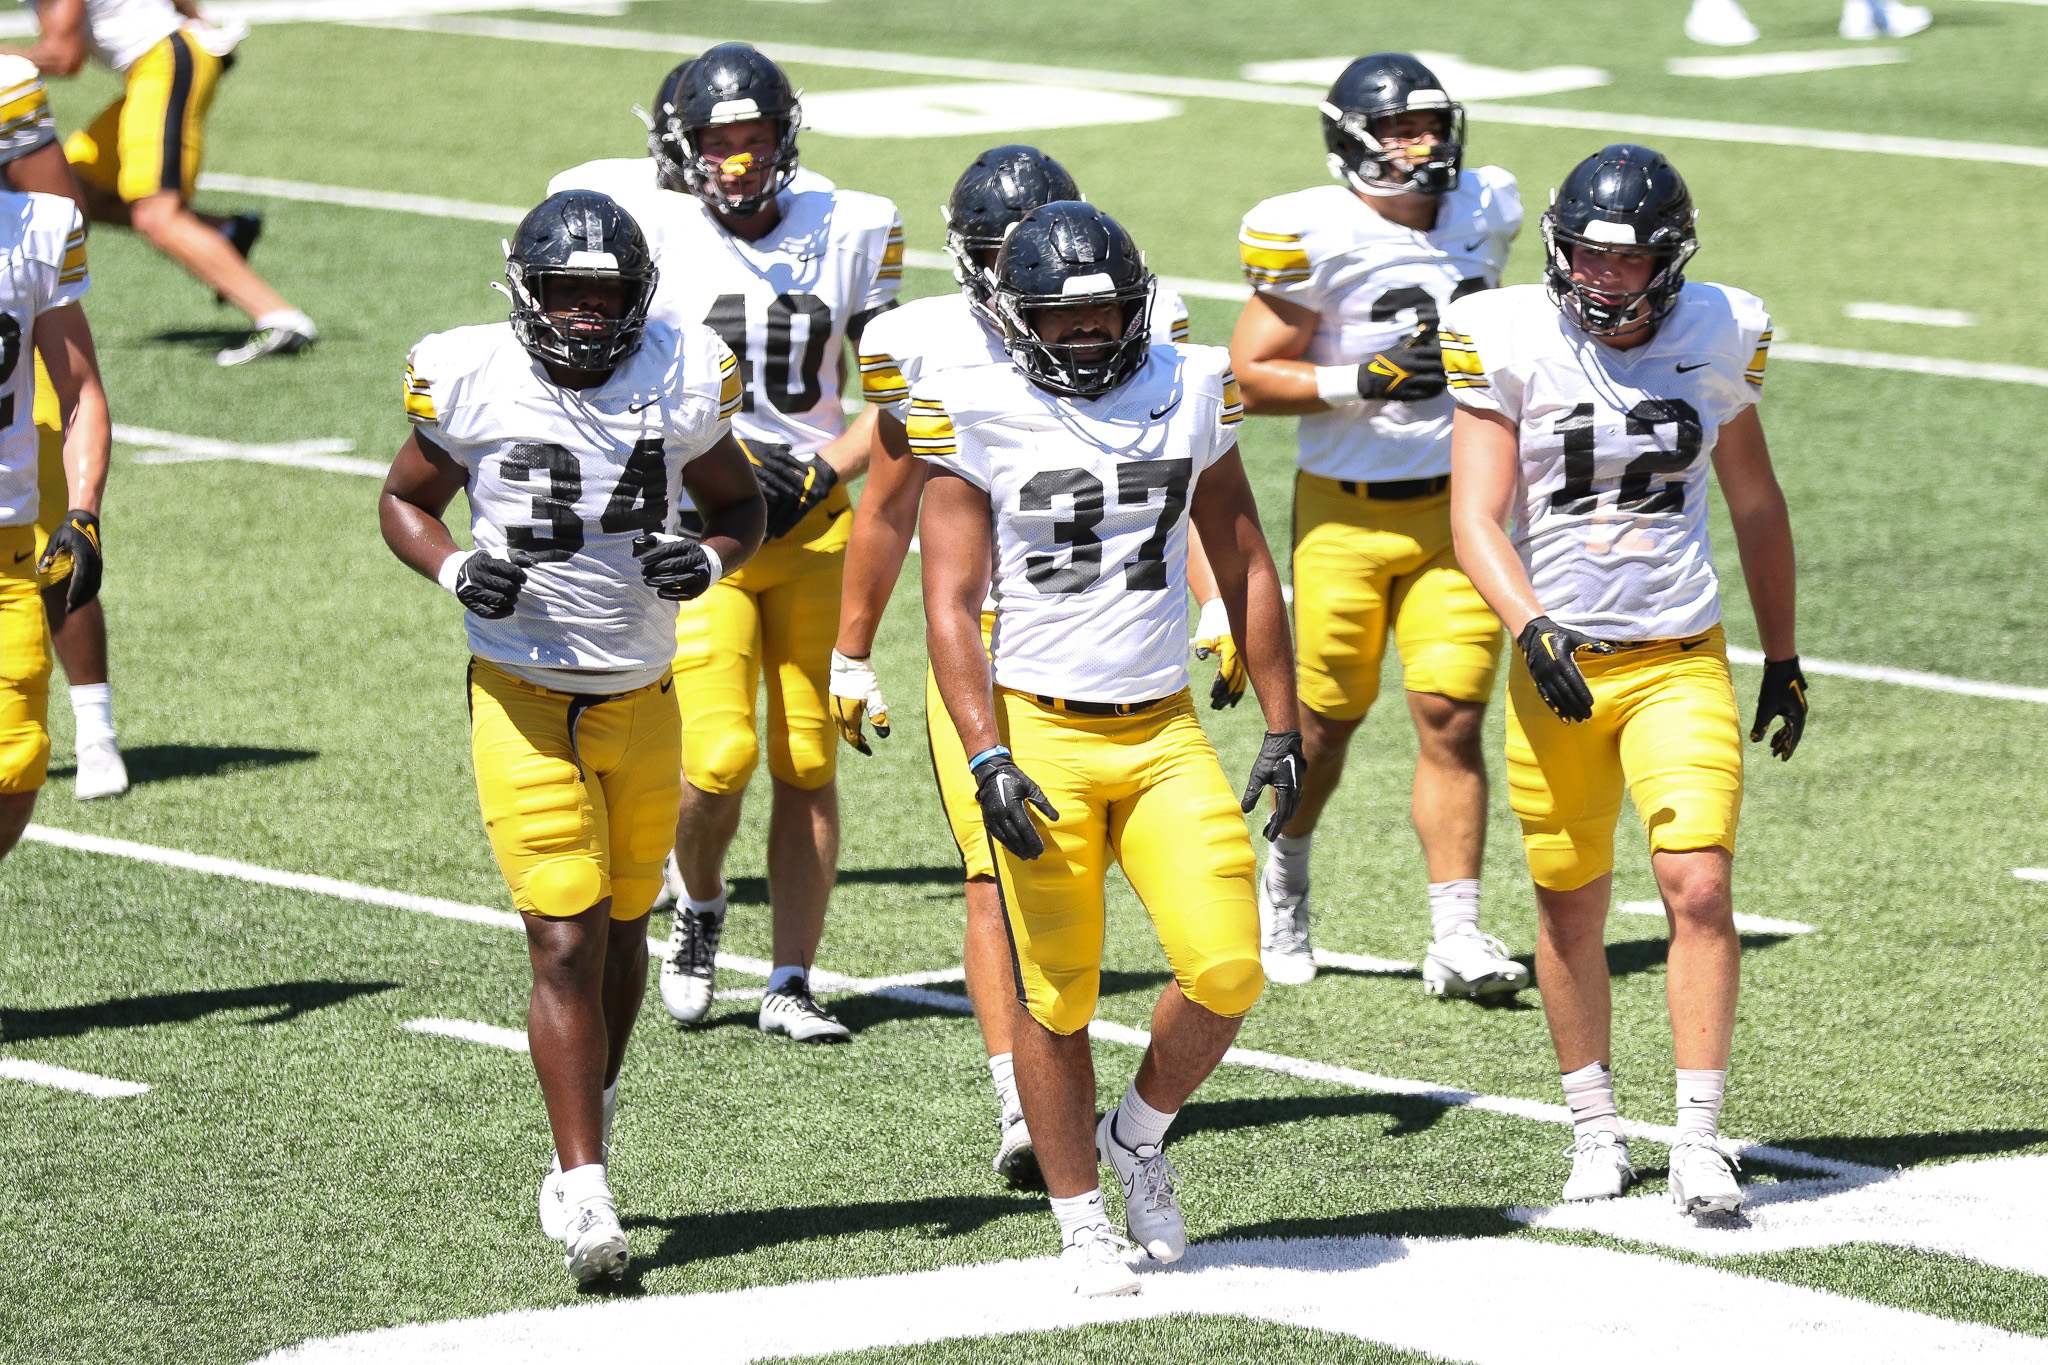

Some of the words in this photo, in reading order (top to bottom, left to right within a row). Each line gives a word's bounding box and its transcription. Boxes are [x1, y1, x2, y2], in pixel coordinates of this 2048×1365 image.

[500, 438, 668, 562] 34
[1550, 398, 1703, 515] 12
[1019, 457, 1192, 594] 37
